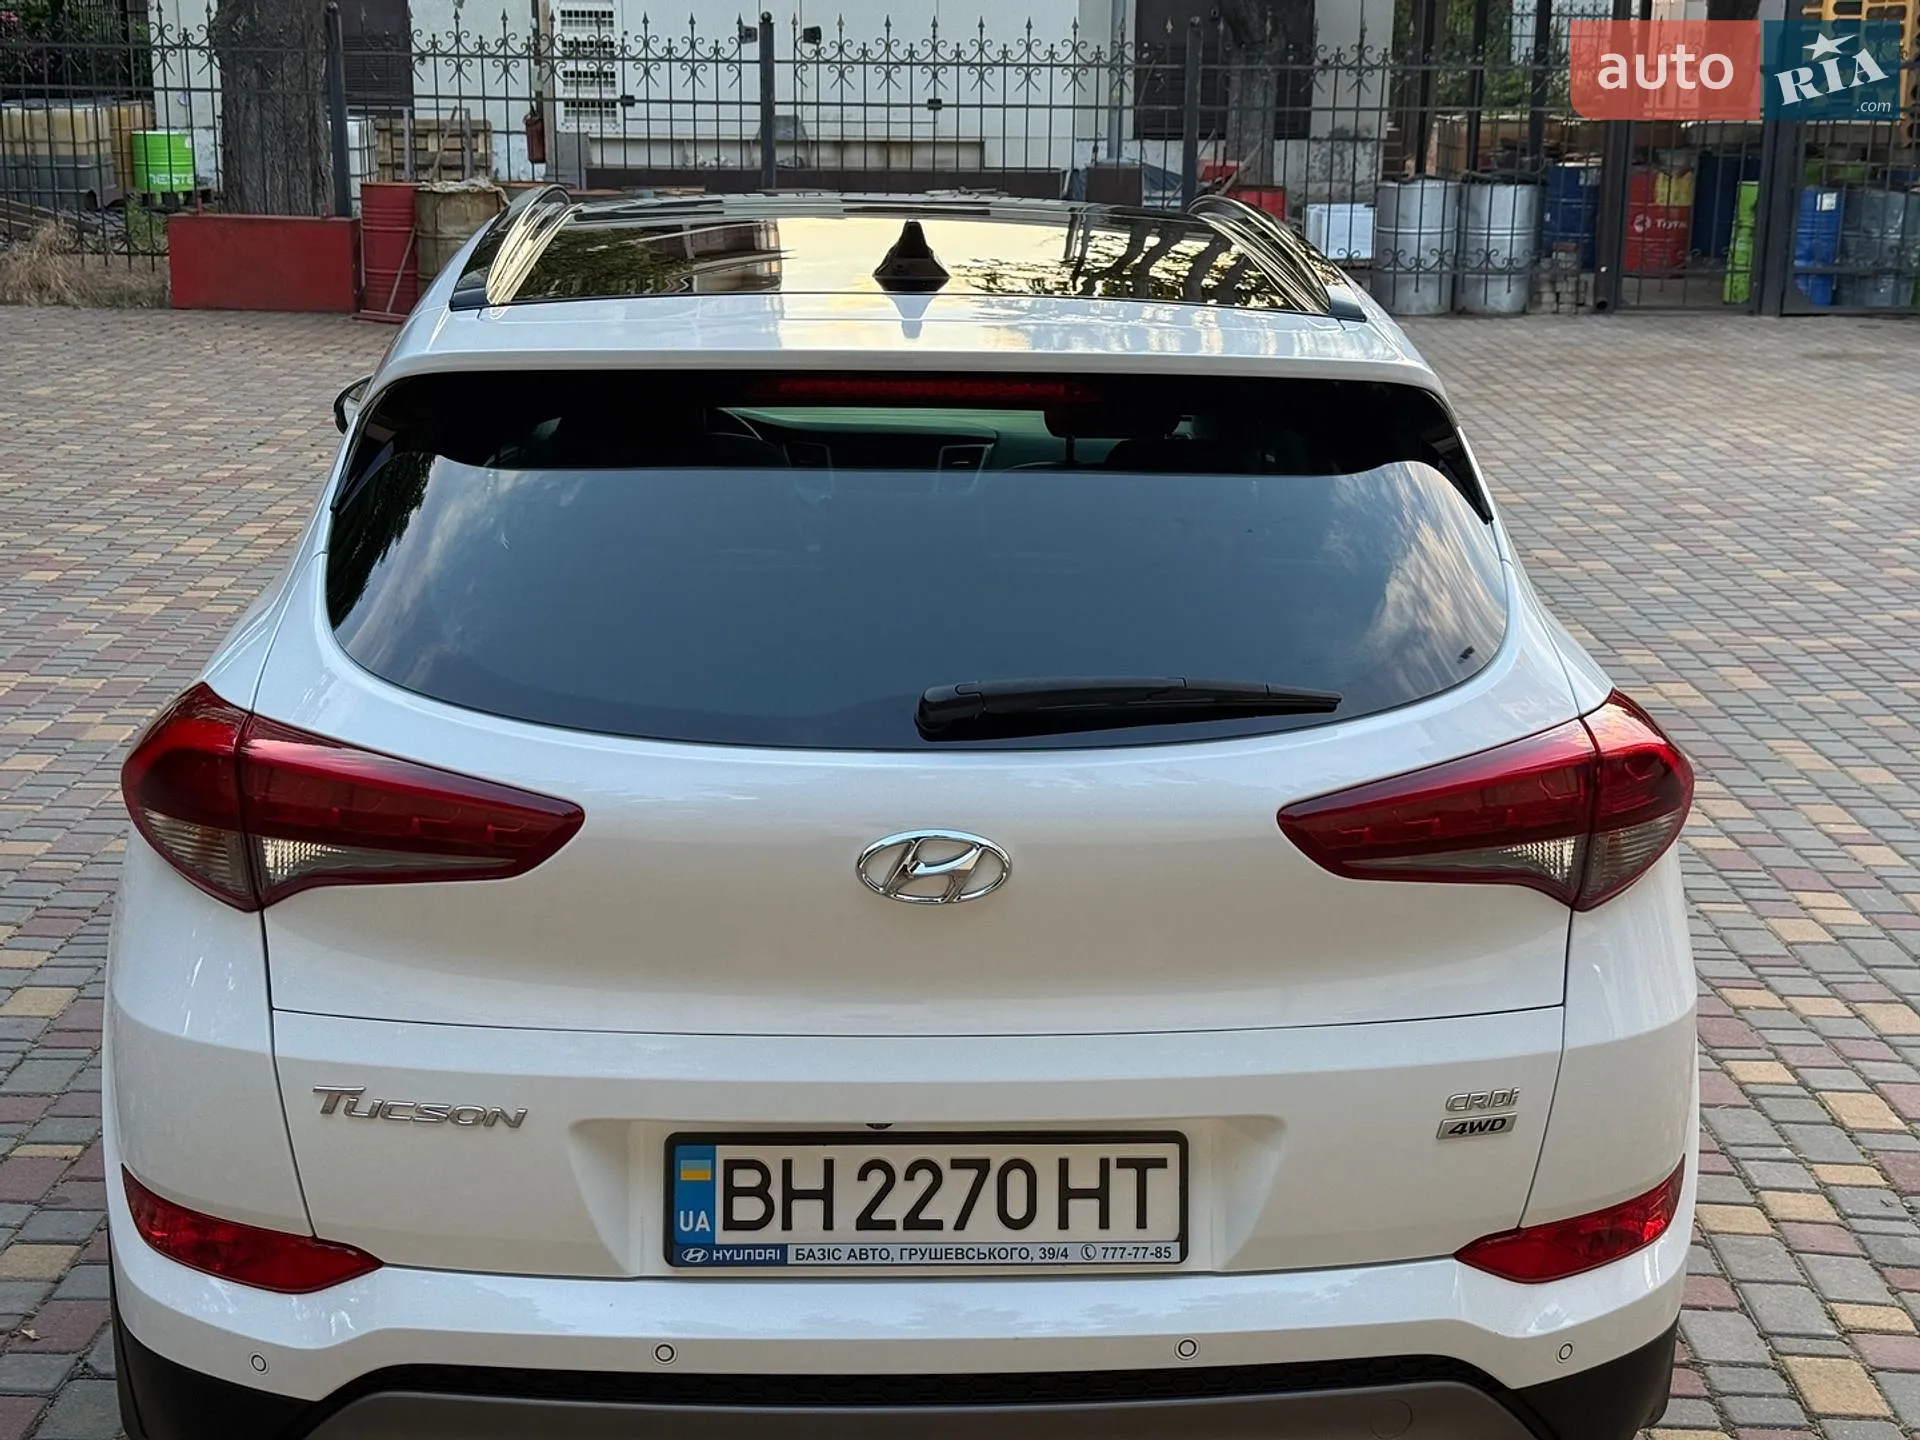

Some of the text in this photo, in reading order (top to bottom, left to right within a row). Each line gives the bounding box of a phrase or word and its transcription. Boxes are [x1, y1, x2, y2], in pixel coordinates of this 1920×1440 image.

[312, 1085, 528, 1129] TUCSON
[1446, 1087, 1520, 1112] CRDi
[1448, 1118, 1507, 1135] 4WD
[723, 1157, 1168, 1231] BH 2270 HT
[679, 1210, 711, 1232] UA
[712, 1248, 780, 1261] HYUNDAI
[795, 1246, 1172, 1263] БАЗІС АВТО, ГРУШЕВСЬКОГО, 39/4 777-77-85
